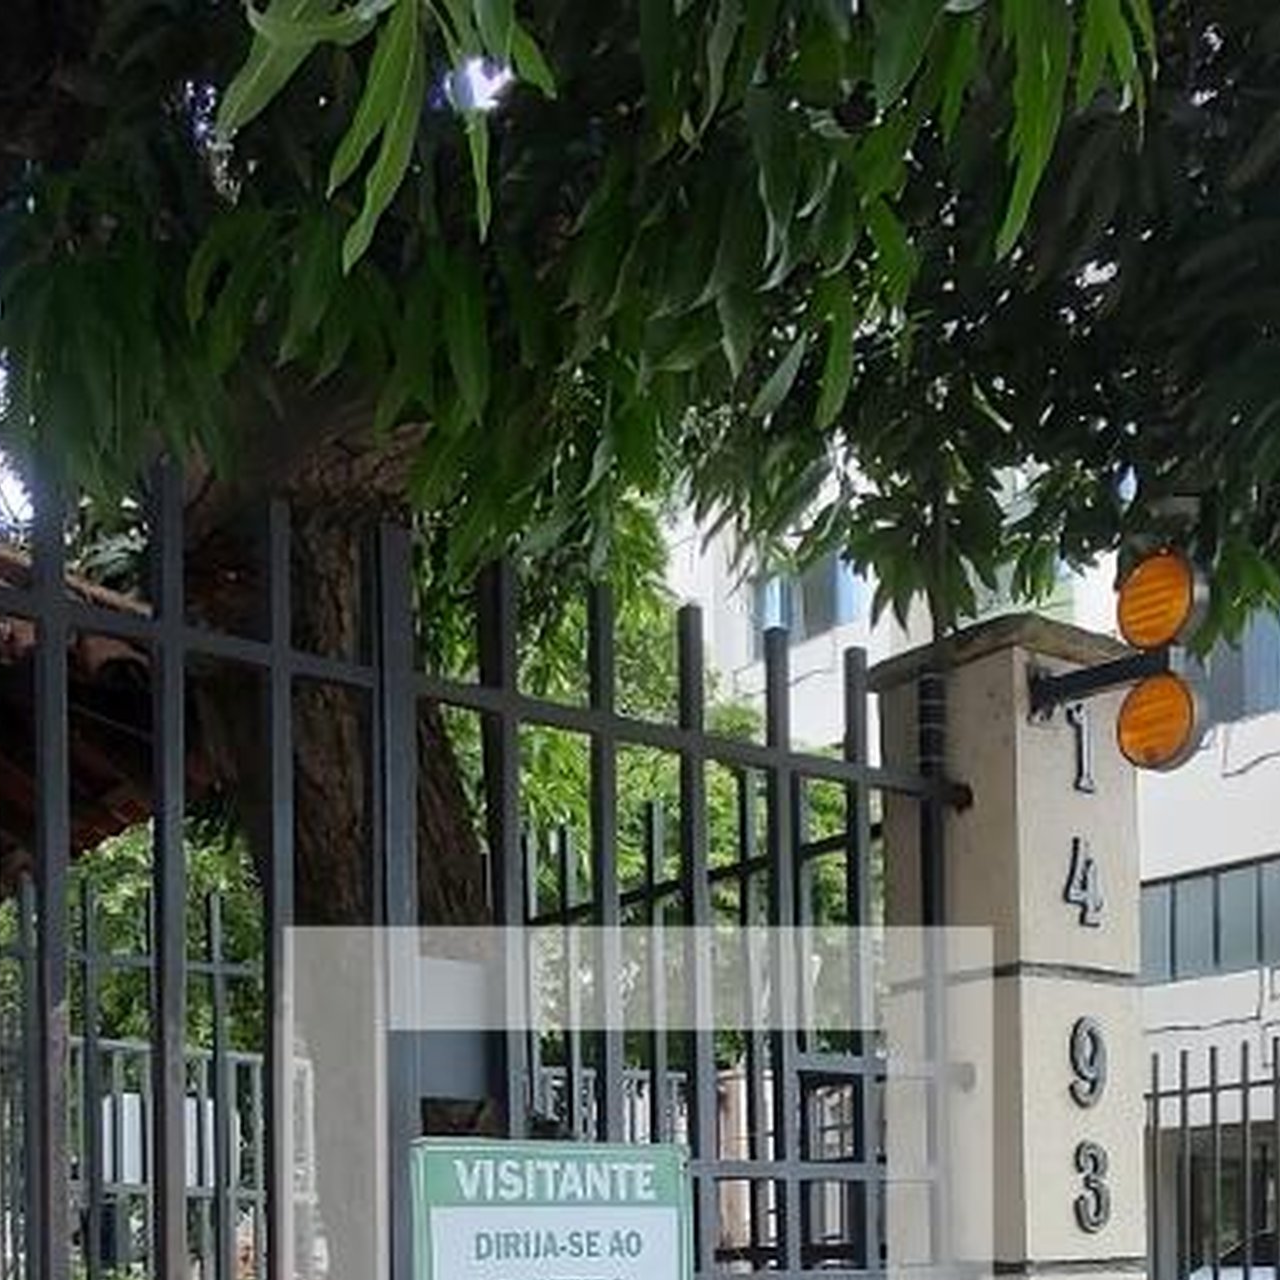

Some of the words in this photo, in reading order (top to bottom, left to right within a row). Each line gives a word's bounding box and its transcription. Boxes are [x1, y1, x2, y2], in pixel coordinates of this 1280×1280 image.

[453, 1158, 657, 1201] VISITANTE
[475, 1231, 601, 1261] DIRIJA-SE
[607, 1230, 643, 1258] AO
